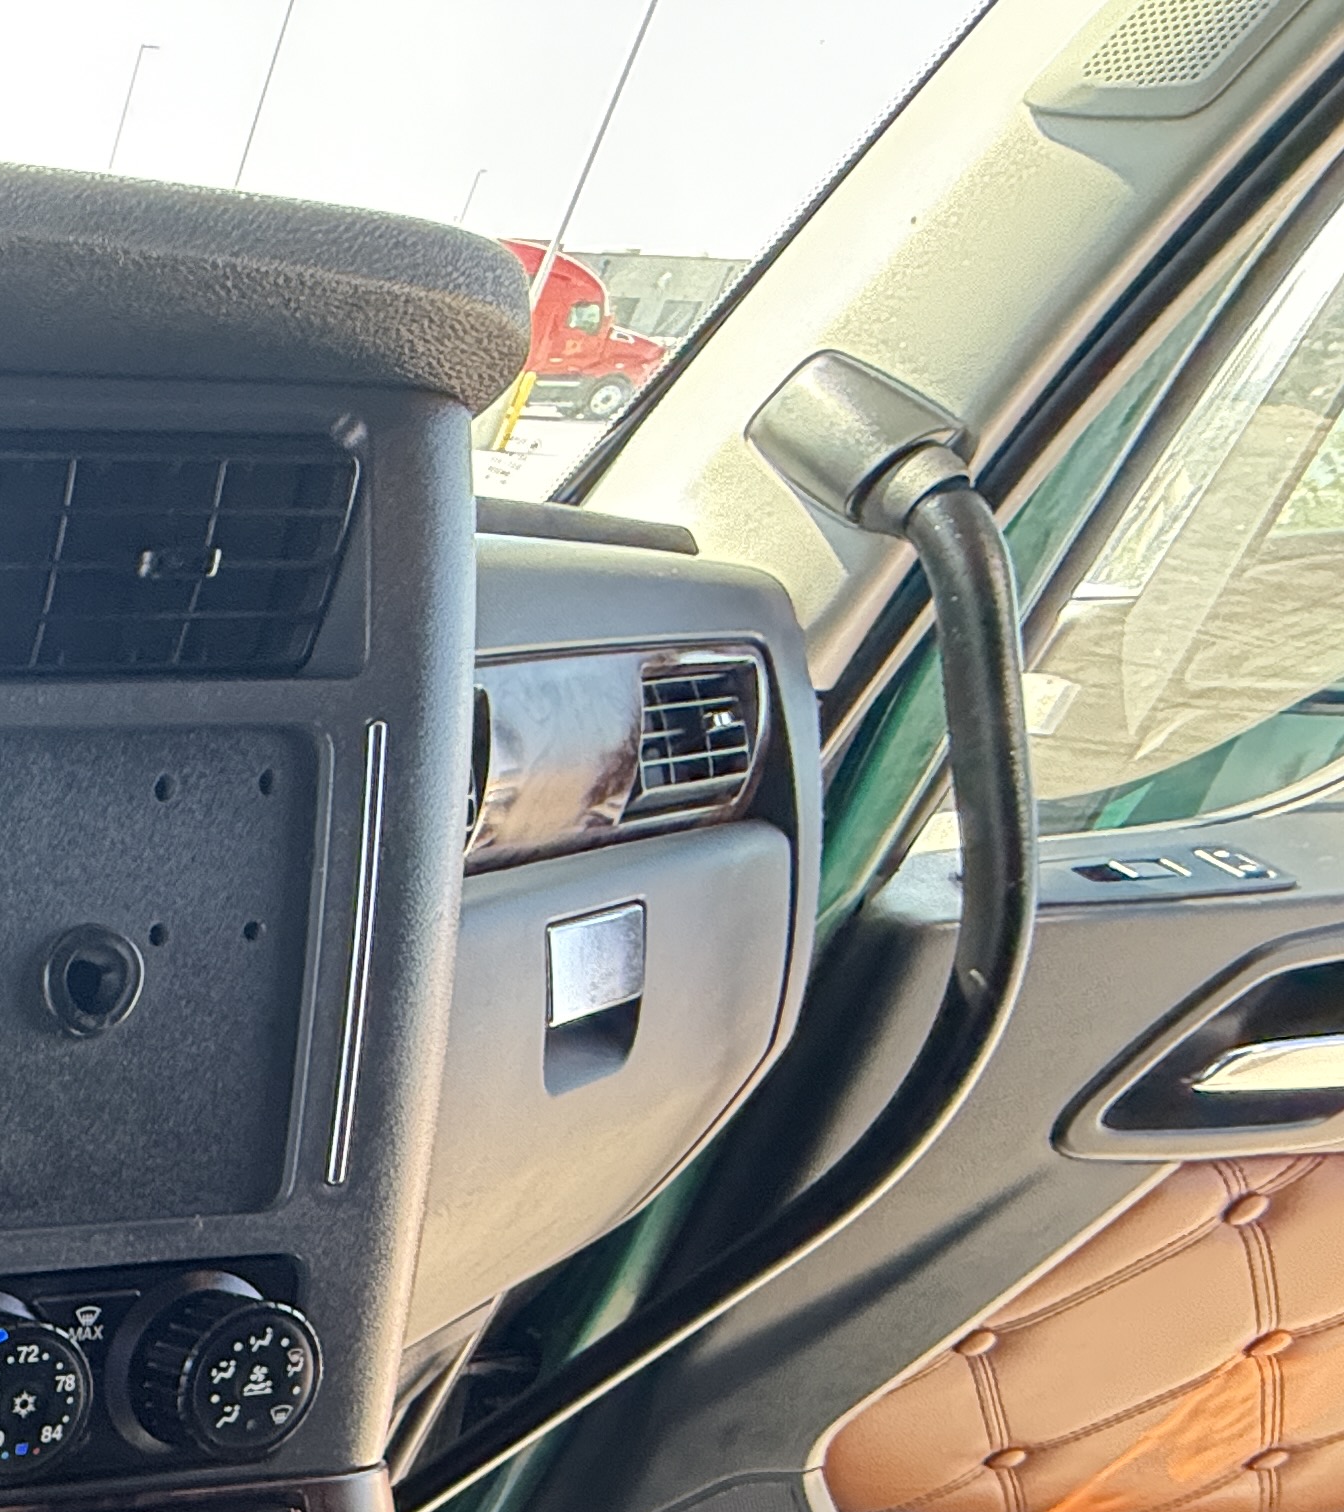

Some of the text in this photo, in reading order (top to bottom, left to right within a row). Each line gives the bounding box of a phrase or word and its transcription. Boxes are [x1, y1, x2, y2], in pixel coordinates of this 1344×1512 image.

[68, 1325, 104, 1342] MAX
[16, 1344, 40, 1363] 72
[55, 1373, 76, 1393] 78
[40, 1424, 63, 1444] 84
